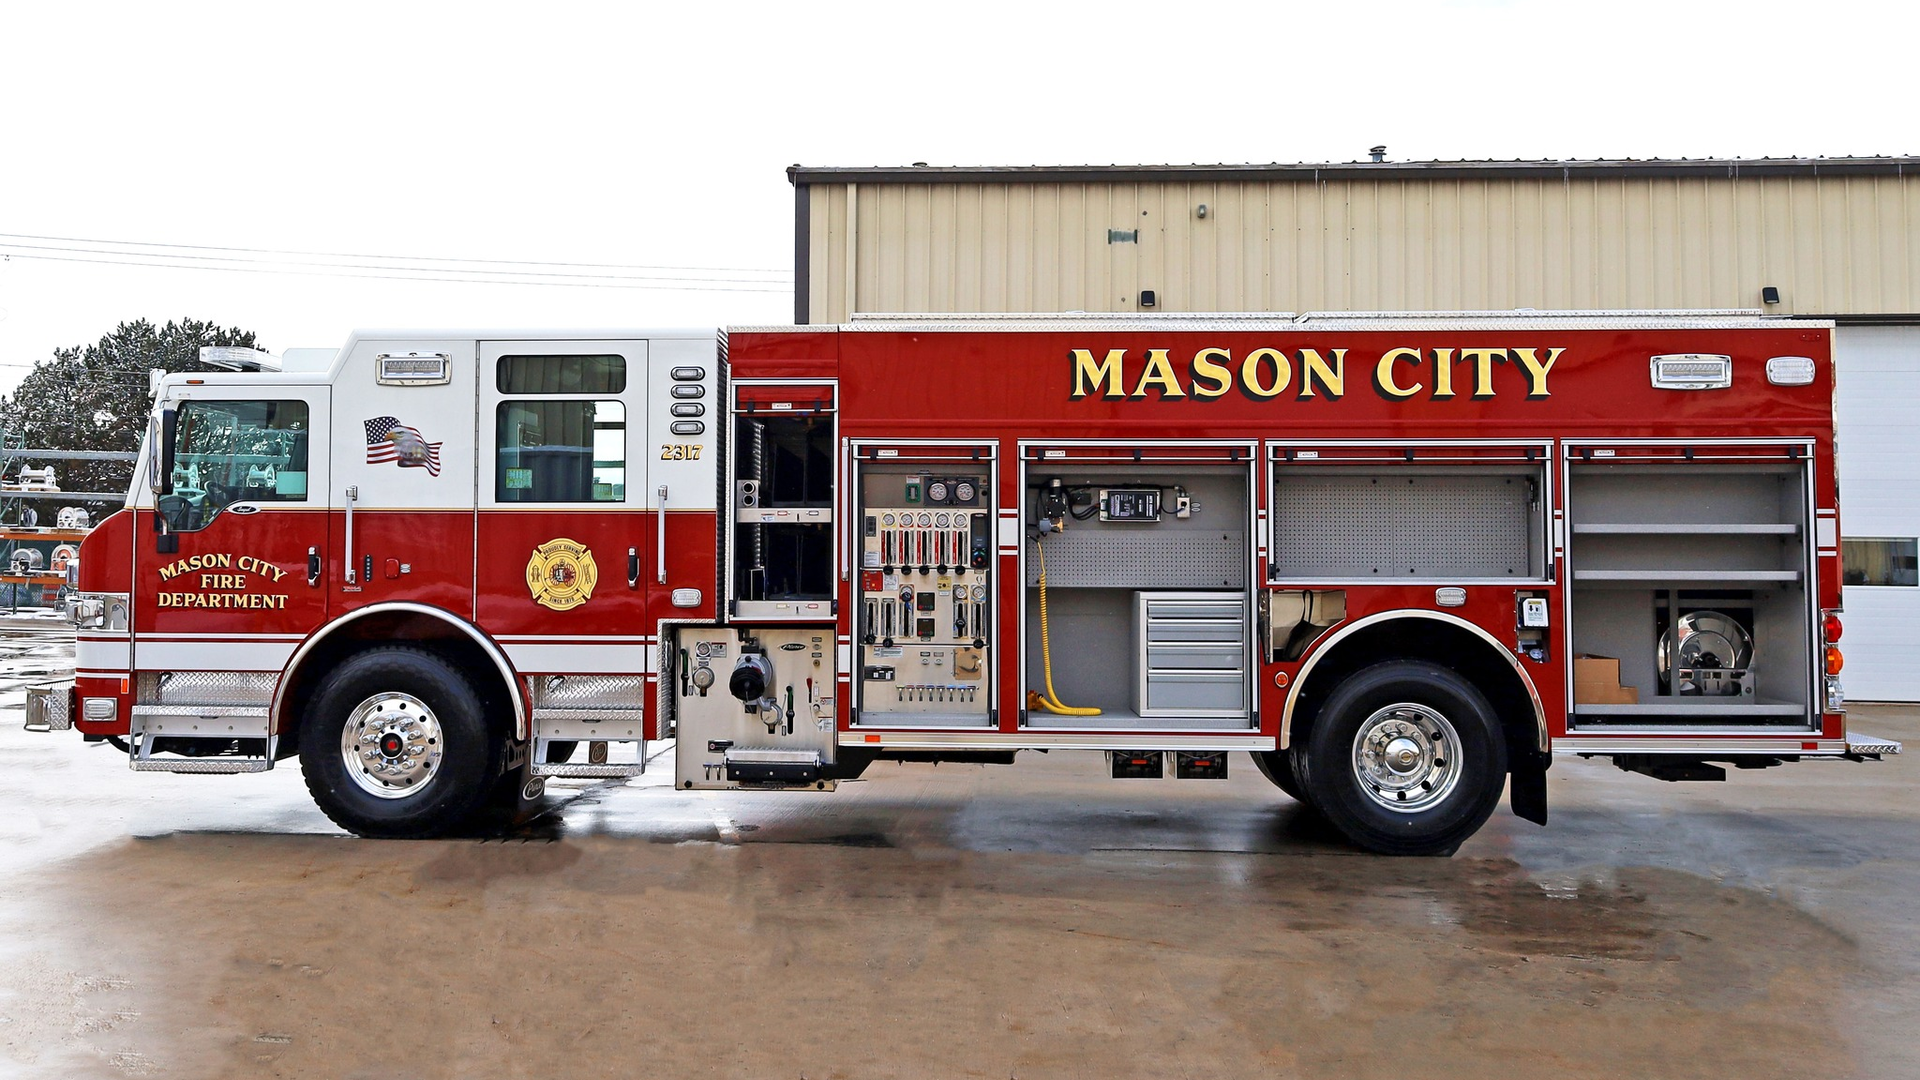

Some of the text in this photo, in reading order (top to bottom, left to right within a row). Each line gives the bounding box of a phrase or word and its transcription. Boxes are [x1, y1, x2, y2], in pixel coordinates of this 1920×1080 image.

[1068, 346, 1567, 400] MASON CITY
[661, 444, 703, 461] 2317
[158, 553, 288, 583] MASON CITY
[200, 573, 247, 590] FIRE
[157, 592, 289, 610] DEPARTMENT
